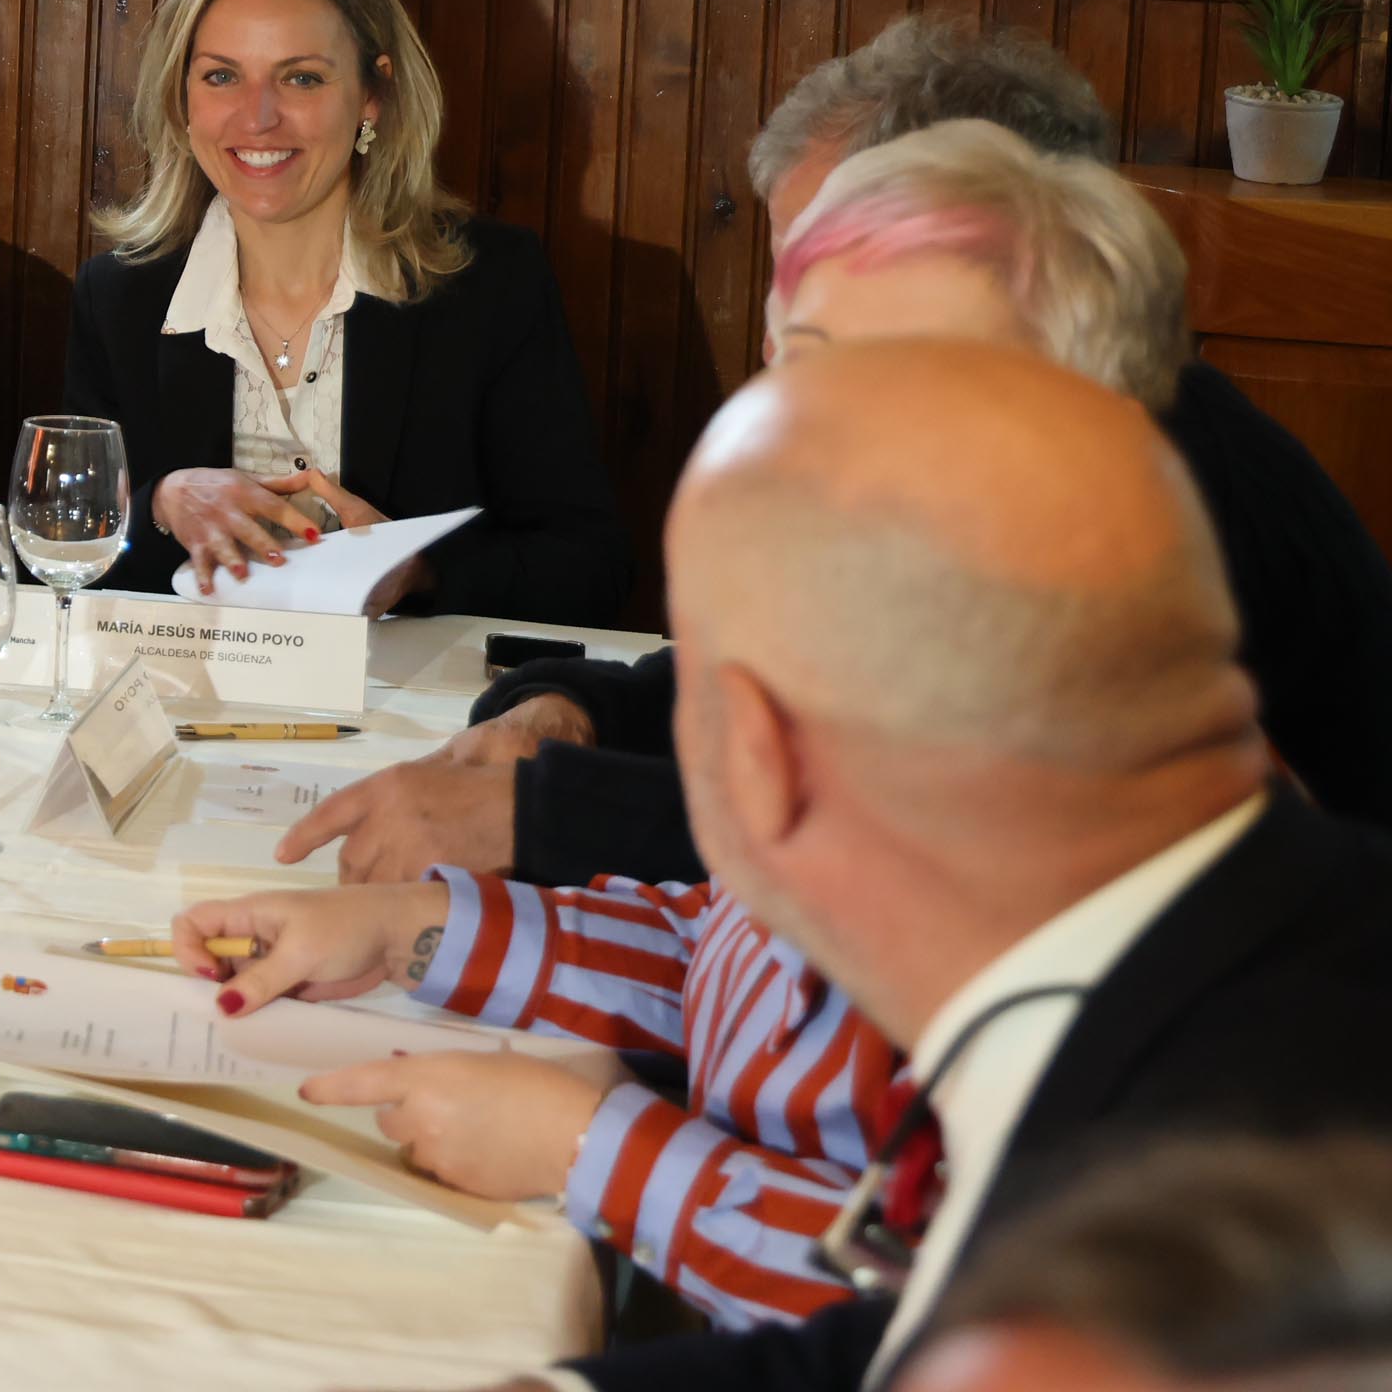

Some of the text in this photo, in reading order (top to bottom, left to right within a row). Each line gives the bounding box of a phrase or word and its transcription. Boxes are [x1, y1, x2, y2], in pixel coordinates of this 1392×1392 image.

[10, 636, 36, 645] Mancha
[96, 620, 304, 648] MARÍA JESÚS MERINO POYO
[134, 646, 272, 665] ALCALDESA DE SIGÜENZA
